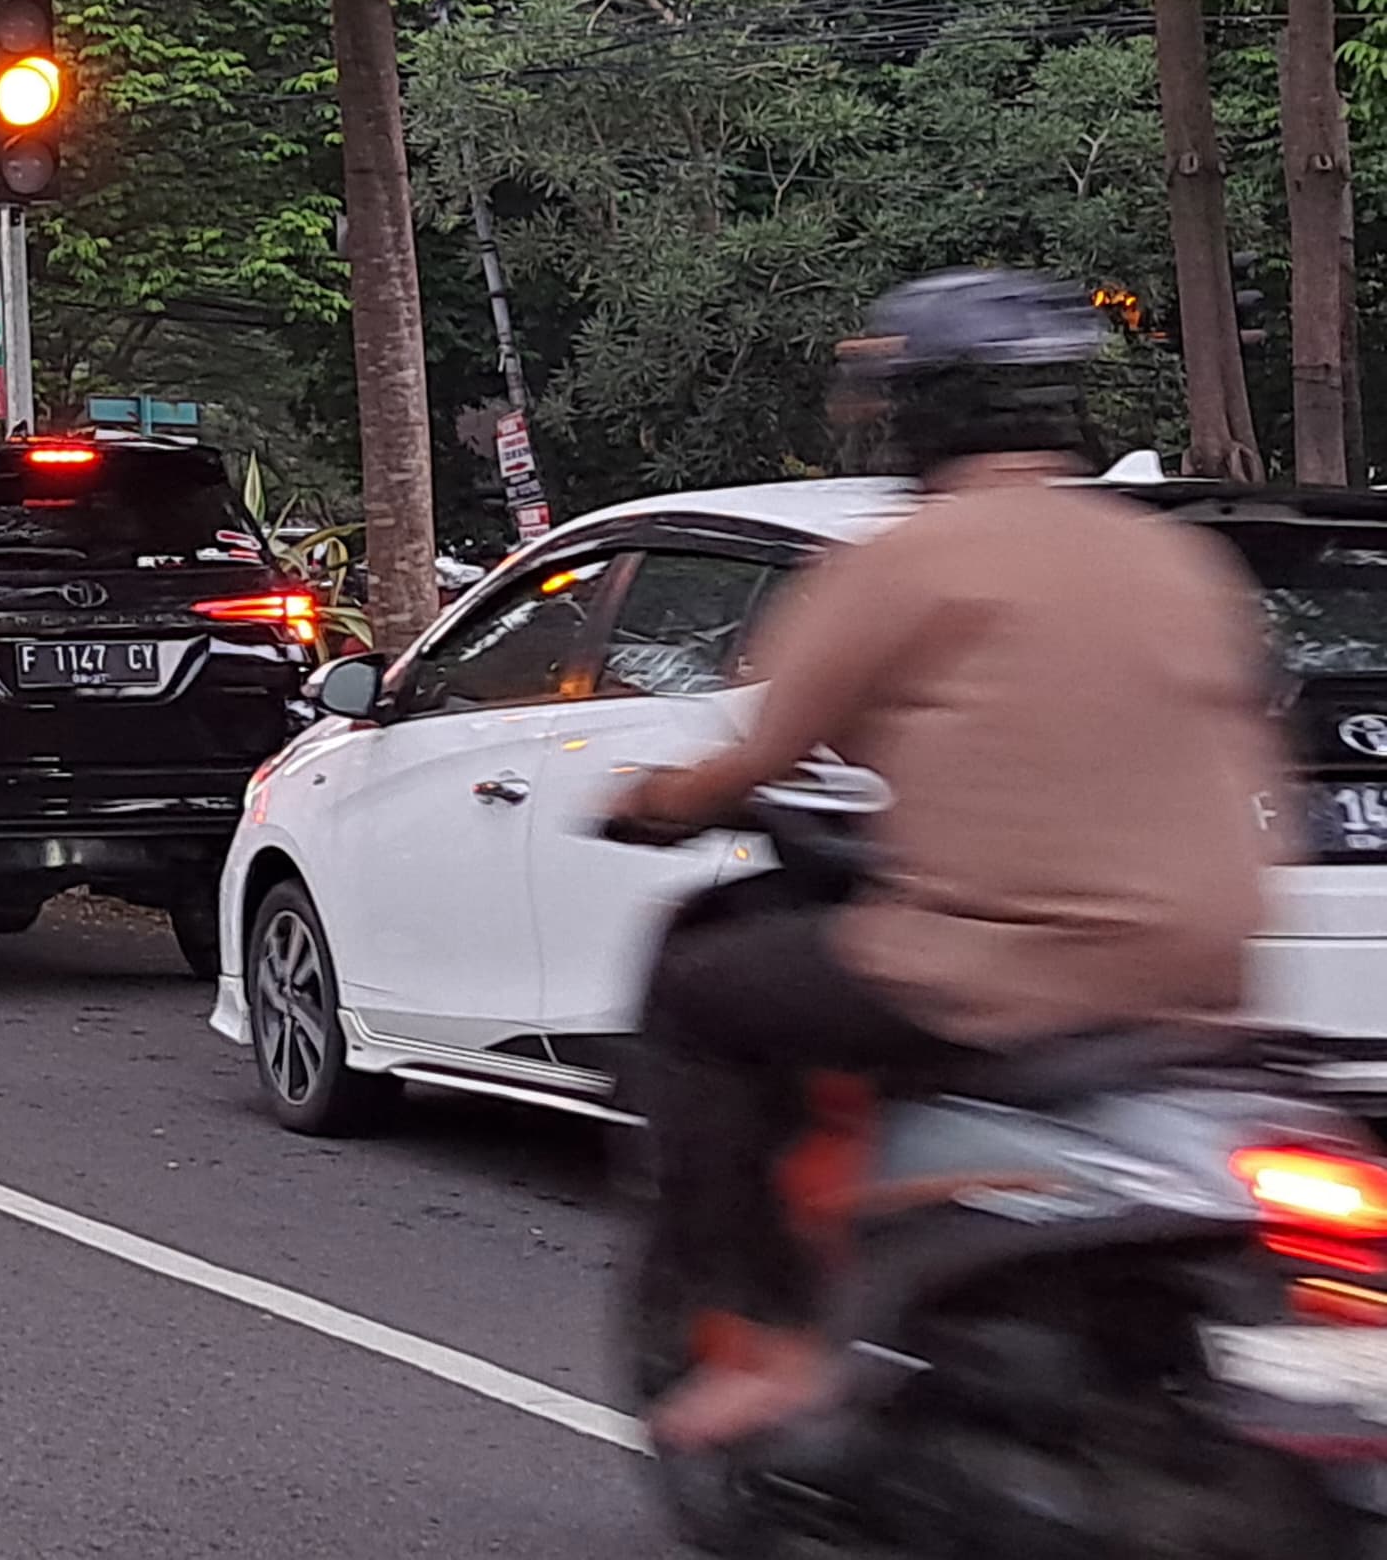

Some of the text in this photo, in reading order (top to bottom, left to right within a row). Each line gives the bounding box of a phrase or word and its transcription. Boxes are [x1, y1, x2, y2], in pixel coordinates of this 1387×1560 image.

[22, 644, 153, 672] F 1147 CY
